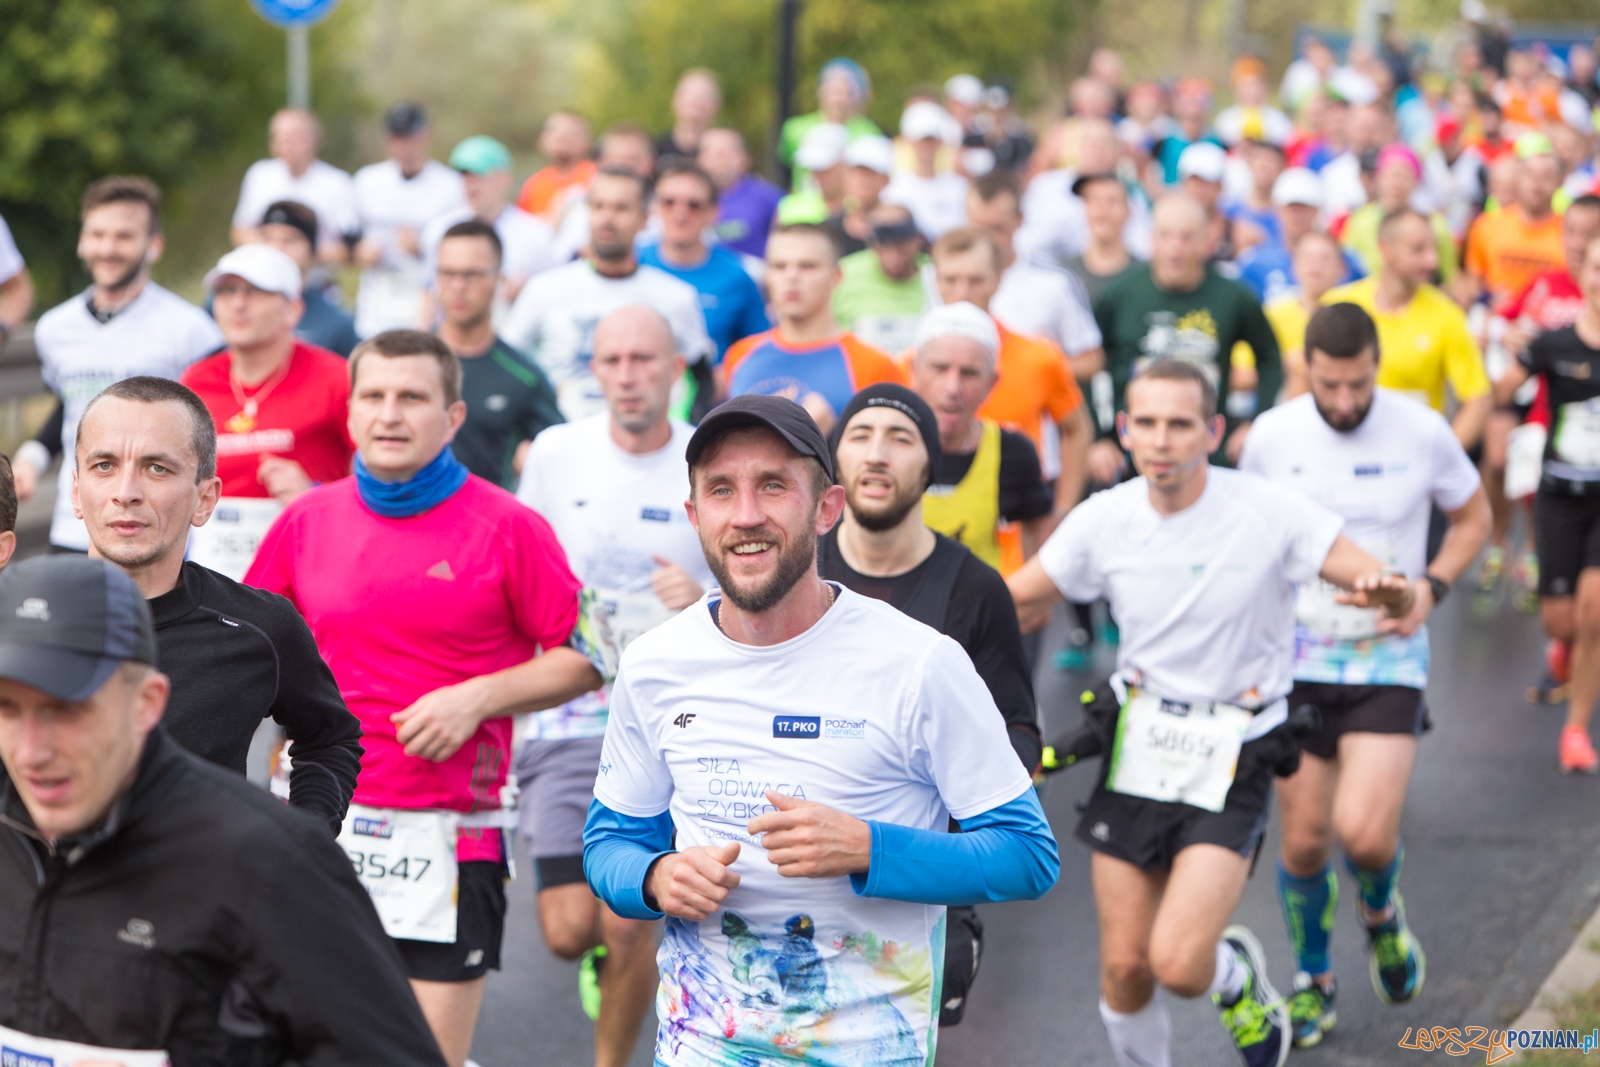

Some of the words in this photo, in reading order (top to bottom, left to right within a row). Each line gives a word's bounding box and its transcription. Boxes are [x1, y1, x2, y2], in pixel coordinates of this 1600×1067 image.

[673, 713, 697, 729] 4F
[823, 728, 865, 736] maraton
[697, 757, 742, 775] SIŁA
